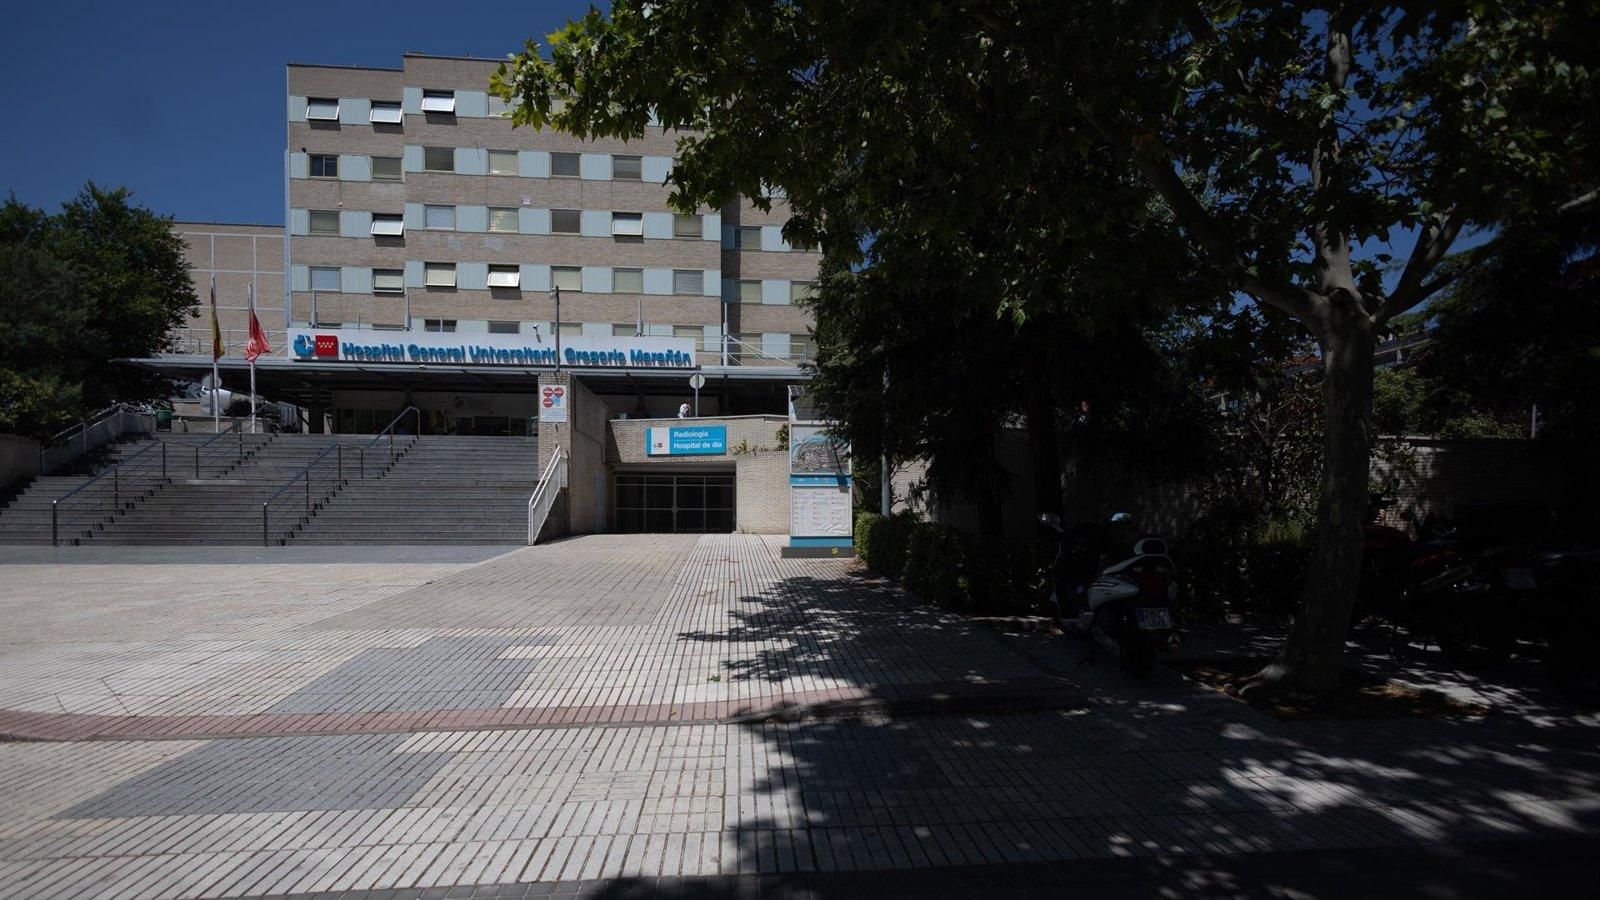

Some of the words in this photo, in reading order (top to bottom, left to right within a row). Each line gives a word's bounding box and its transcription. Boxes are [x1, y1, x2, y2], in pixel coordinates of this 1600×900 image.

[342, 342, 405, 358] Hospital
[407, 344, 466, 359] General
[468, 346, 556, 362] Universitario
[564, 347, 627, 364] Gregorio
[629, 348, 692, 364] Marañón
[673, 441, 701, 450] Hospital
[702, 441, 711, 449] de
